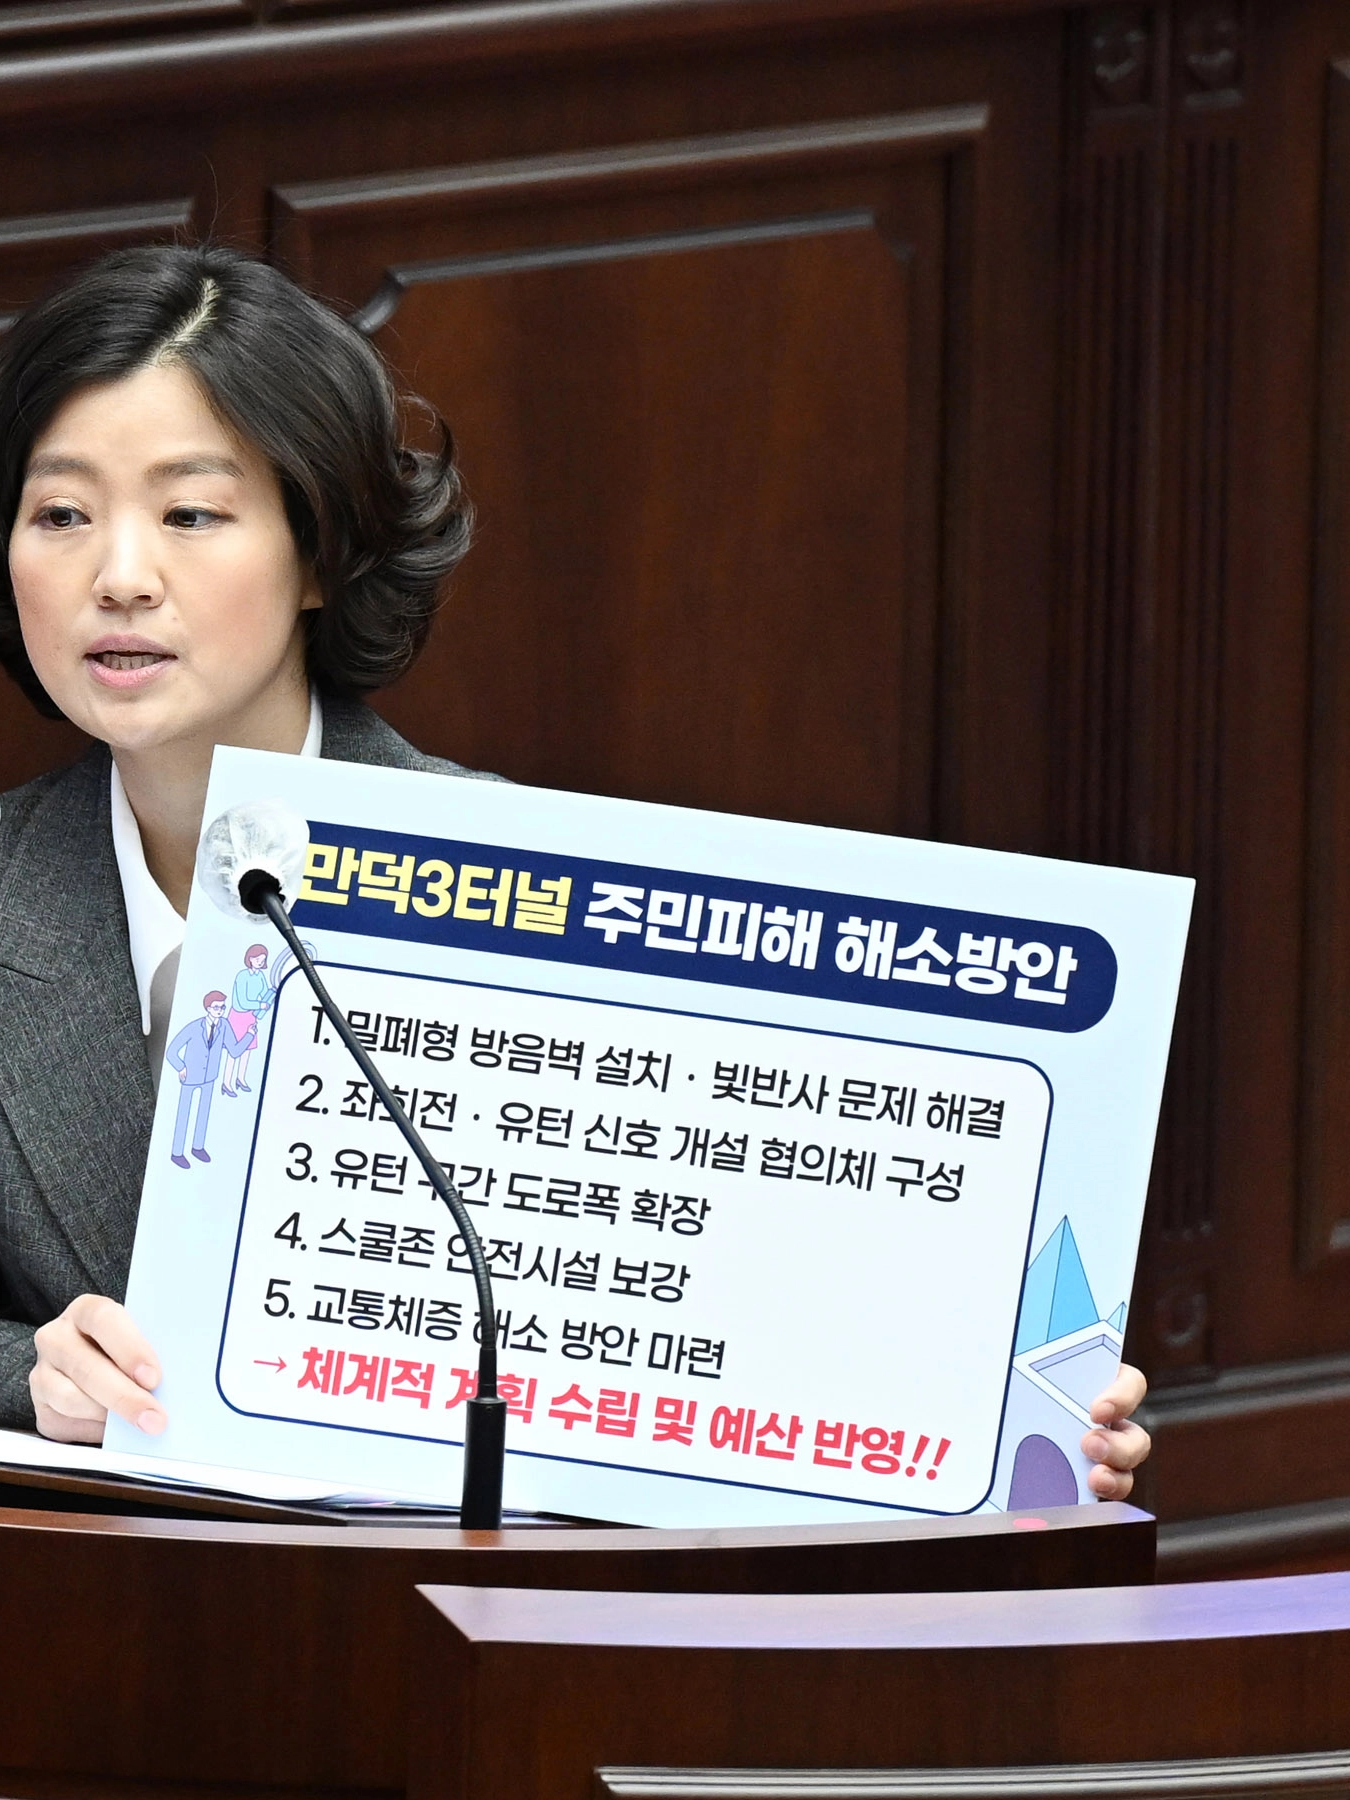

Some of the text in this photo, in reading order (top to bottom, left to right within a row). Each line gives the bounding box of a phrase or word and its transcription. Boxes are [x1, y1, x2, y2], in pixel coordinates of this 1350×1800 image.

[298, 842, 1078, 1005] 만덕3터널 주민피해 해소방안
[311, 1005, 332, 1047] 1.
[344, 1009, 460, 1063] 밀폐형
[469, 1027, 585, 1081] 방음벽
[595, 1045, 672, 1093] 설치
[711, 1060, 830, 1115] 빛반사
[838, 1078, 917, 1128] 문제
[926, 1091, 1005, 1140] 해결
[285, 1142, 318, 1183] 3.
[330, 1148, 408, 1195] 유턴
[503, 1172, 621, 1226] 도로폭
[630, 1188, 712, 1236] 확장
[295, 1074, 329, 1115] 2.
[495, 1102, 574, 1149] 유턴
[584, 1114, 660, 1161] 신호
[670, 1125, 749, 1173] 개설
[759, 1137, 877, 1192] 협의체
[885, 1155, 965, 1203] 구성
[274, 1211, 307, 1251] 4.
[318, 1217, 436, 1269] 스쿨존
[608, 1256, 691, 1303] 보강
[263, 1278, 296, 1319] 5.
[306, 1284, 463, 1341] 교통체증
[561, 1319, 640, 1367] 방안
[647, 1332, 726, 1380] 마련
[297, 1346, 436, 1410] 체계적
[548, 1383, 641, 1439] 수립
[652, 1396, 698, 1447] 및
[709, 1405, 804, 1461] 예산
[812, 1419, 952, 1481] 반영!!
